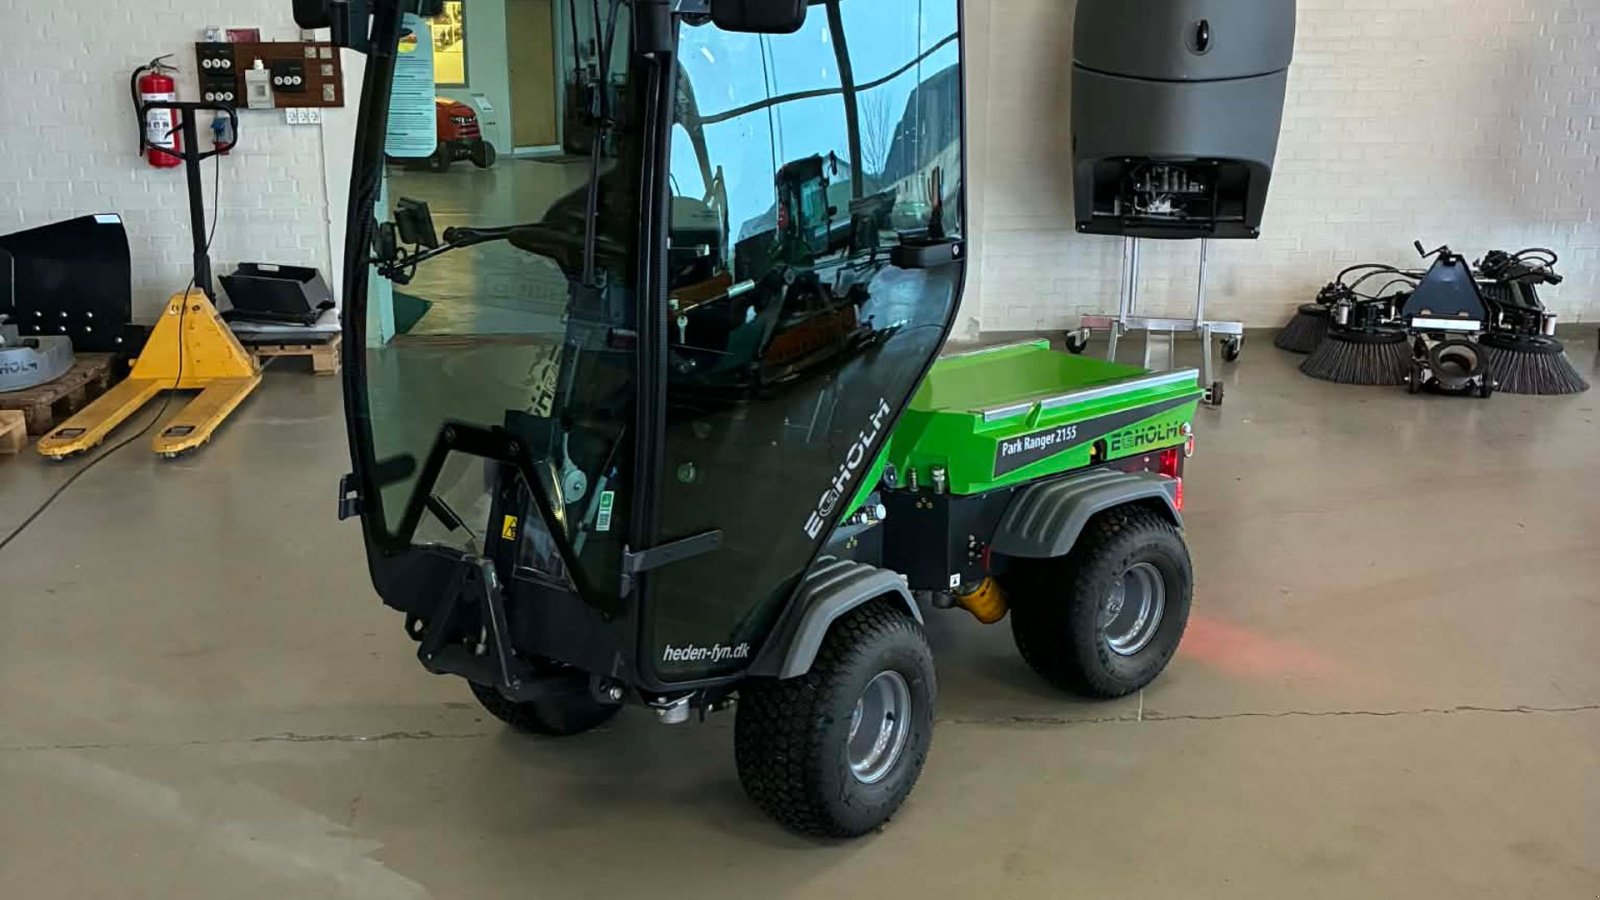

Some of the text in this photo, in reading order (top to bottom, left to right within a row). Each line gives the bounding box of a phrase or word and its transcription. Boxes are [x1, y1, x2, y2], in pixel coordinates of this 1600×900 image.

[1002, 426, 1077, 456] Park Ranger 2155
[1111, 421, 1177, 451] EGHOLM
[804, 397, 890, 540] EGHOLM
[663, 643, 750, 662] heden-fyn.dk
